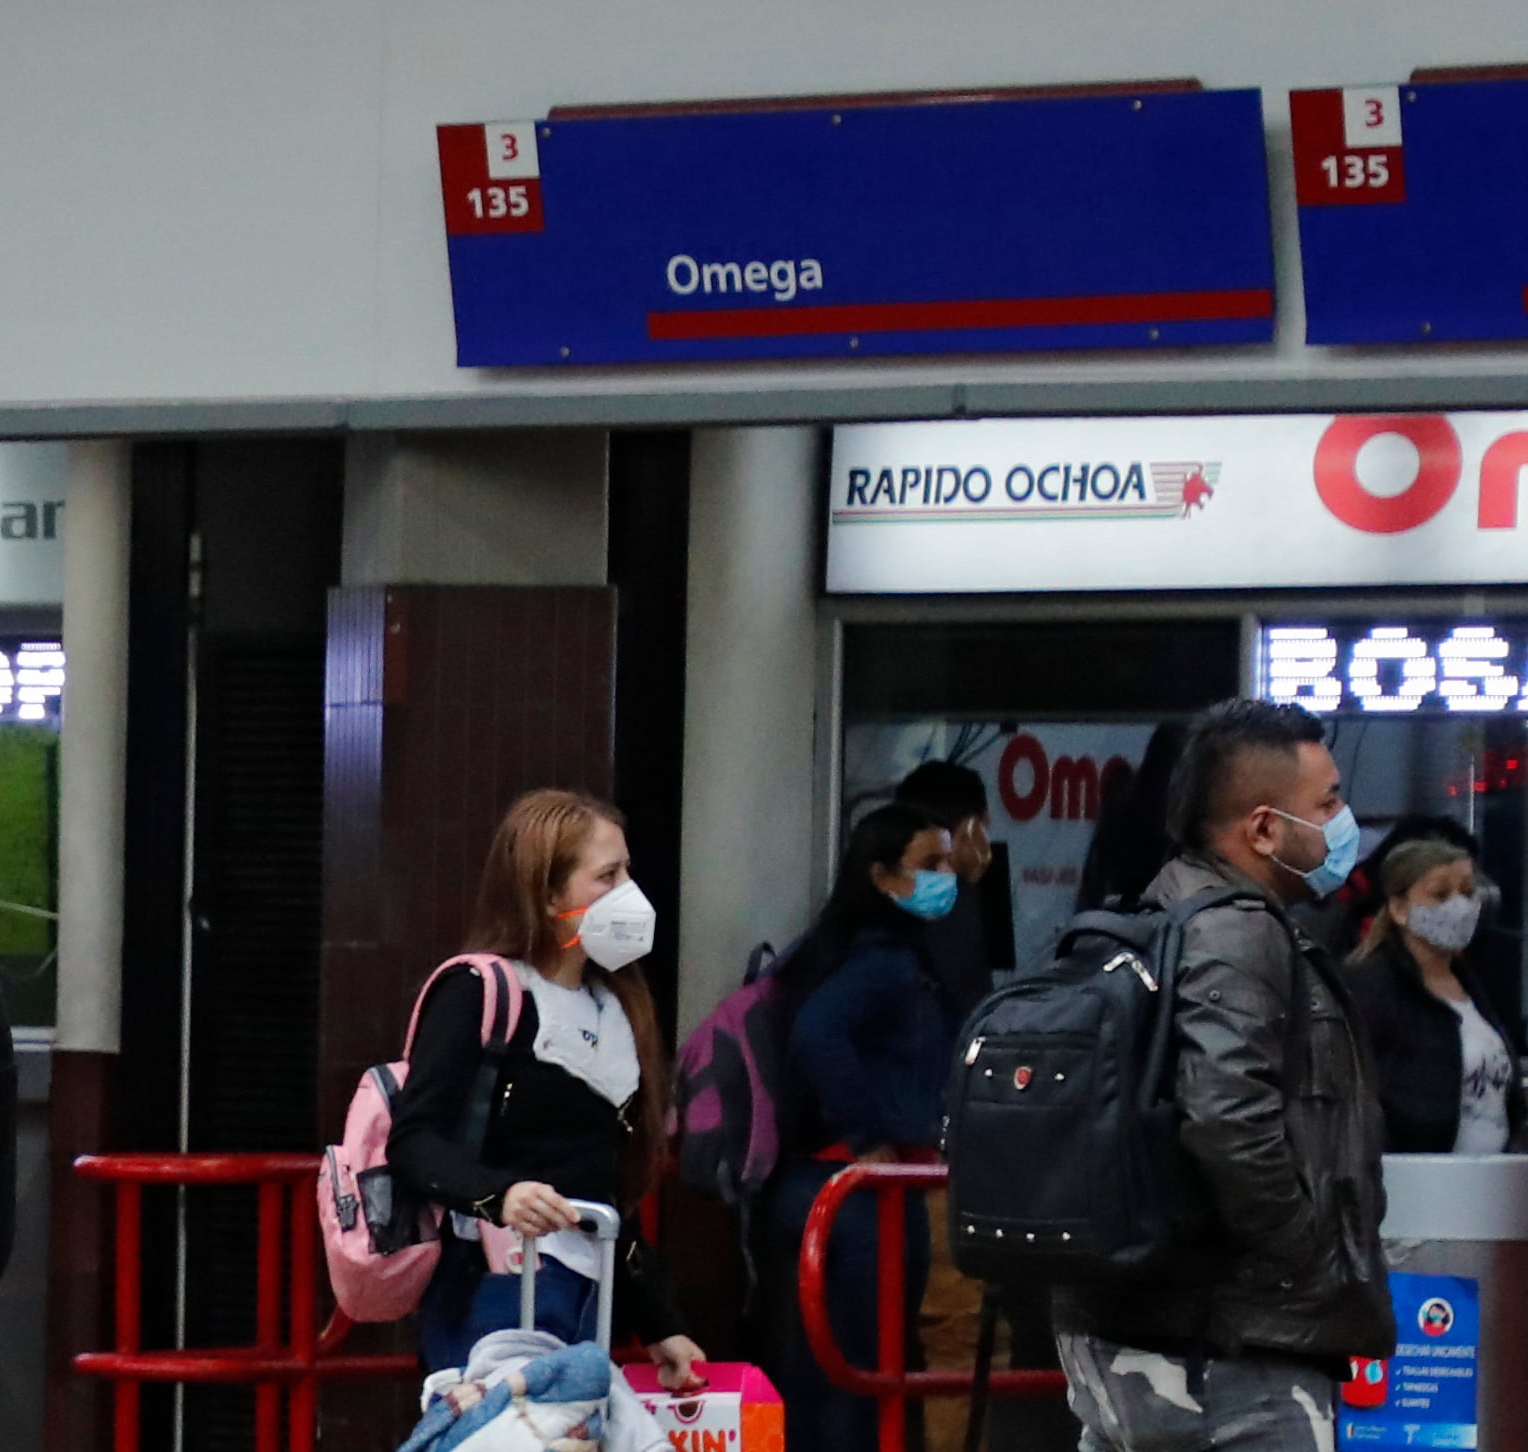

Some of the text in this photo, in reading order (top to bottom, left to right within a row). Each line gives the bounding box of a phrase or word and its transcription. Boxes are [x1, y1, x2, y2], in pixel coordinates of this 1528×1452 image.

[1364, 98, 1385, 127] 3
[500, 134, 520, 161] 3
[1322, 154, 1390, 189] 135
[467, 185, 530, 219] 135
[666, 253, 824, 302] Omega
[846, 461, 1146, 506] RAPIDO OCHOA
